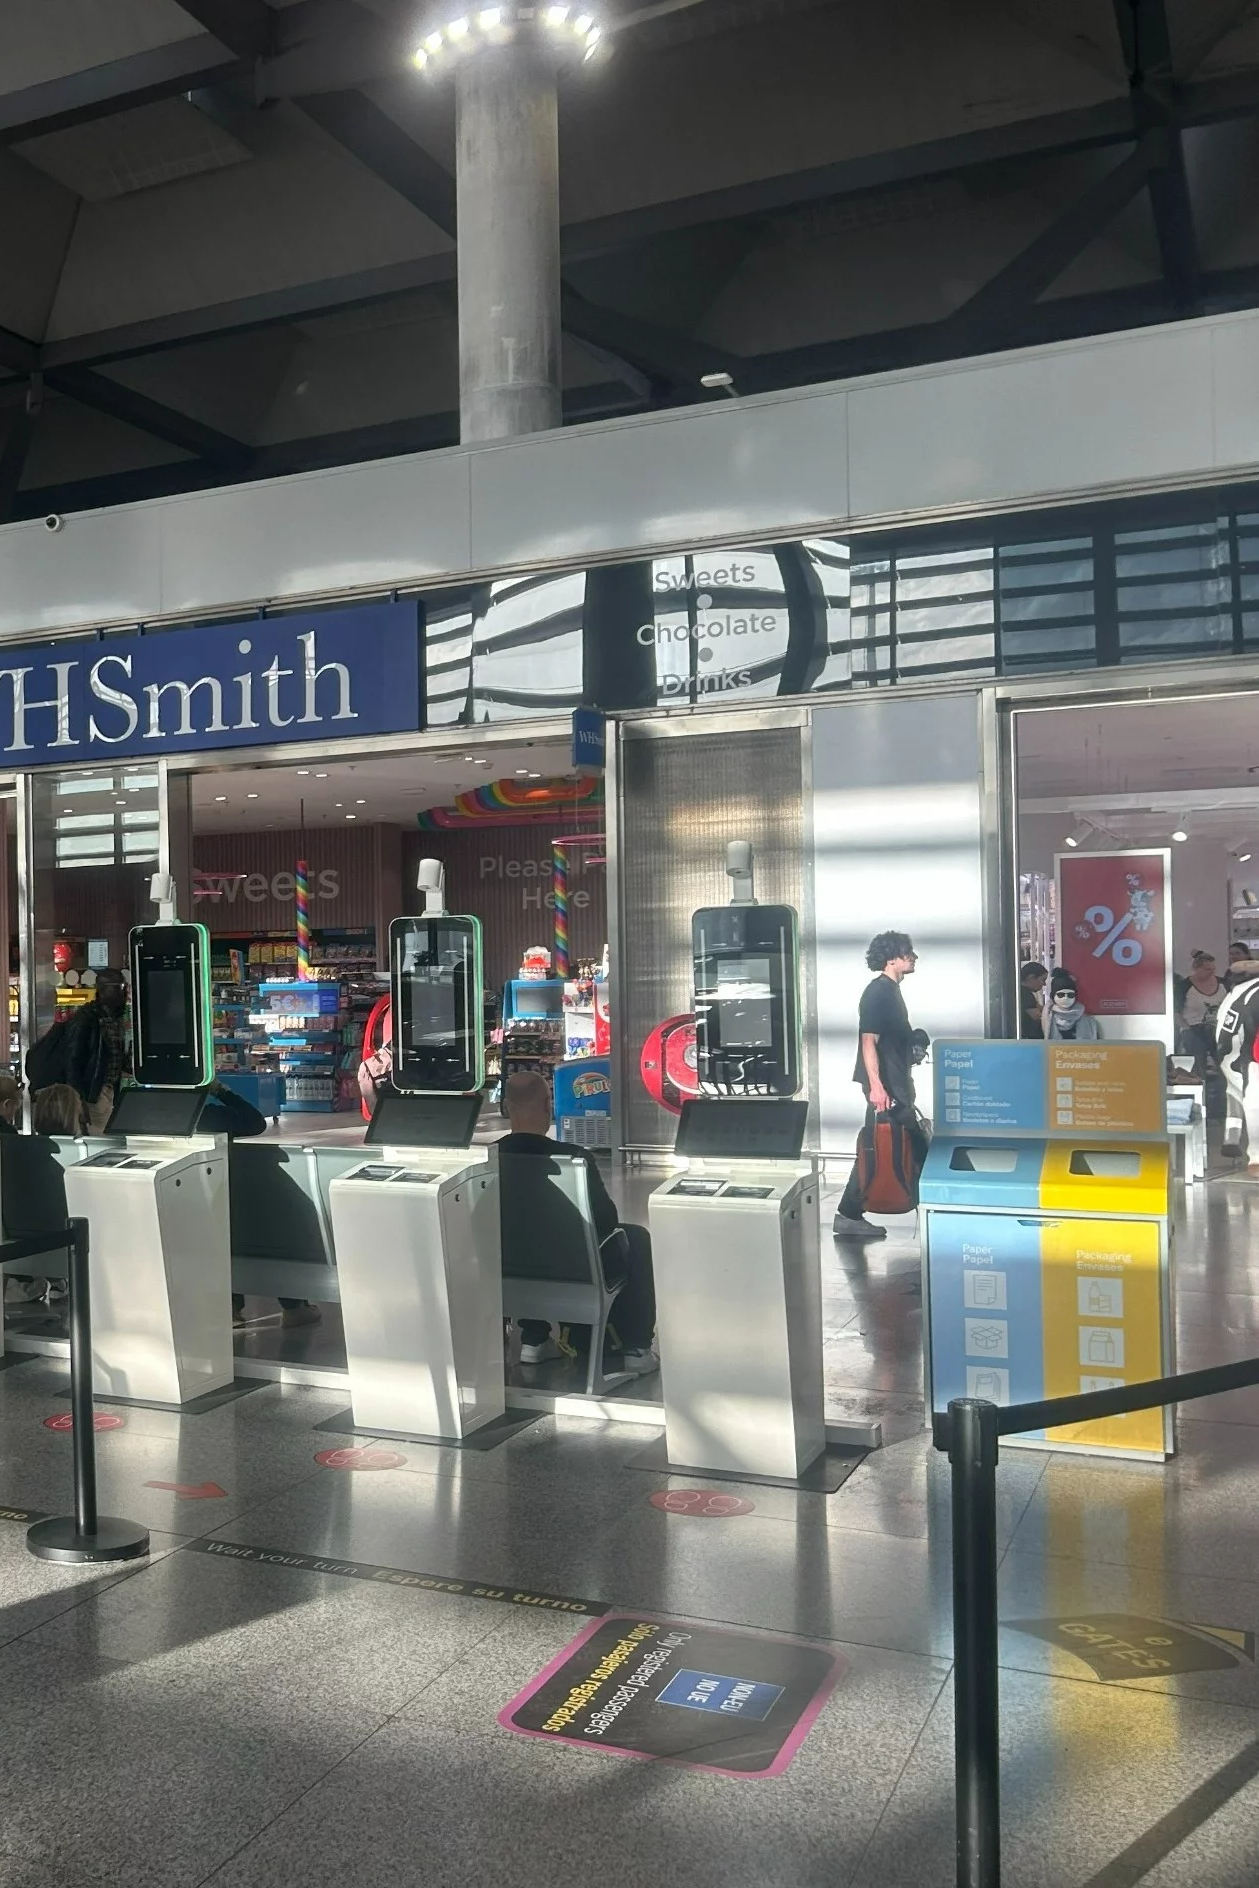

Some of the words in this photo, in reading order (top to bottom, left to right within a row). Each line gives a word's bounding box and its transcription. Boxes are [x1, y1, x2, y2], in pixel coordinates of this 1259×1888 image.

[655, 563, 755, 592] Sweets
[637, 613, 776, 646] Chocolate
[662, 668, 752, 695] Drinks
[479, 854, 571, 878] Pleas
[944, 1049, 972, 1059] Paper
[944, 1059, 974, 1069] Papel
[1055, 1049, 1108, 1061] Packaging
[1055, 1060, 1101, 1069] Envases
[962, 1243, 994, 1255] Paper
[962, 1254, 994, 1265] Papel
[1076, 1250, 1133, 1264] Packaging
[1076, 1260, 1124, 1272] Envases
[205, 1541, 253, 1558] Wait
[255, 1550, 305, 1566] your
[314, 1559, 359, 1575] turn
[371, 1569, 464, 1592] Espere
[470, 1586, 504, 1599] su
[513, 1593, 588, 1612] turno
[656, 1631, 693, 1649] Only
[1059, 1623, 1172, 1669] GATES
[590, 1639, 639, 1680] pasajeros
[626, 1647, 673, 1688] registered
[696, 1679, 720, 1692] NO
[542, 1679, 603, 1732] registrados
[687, 1690, 709, 1704] UE
[720, 1682, 757, 1713] NON-EU
[584, 1684, 641, 1736] passengers
